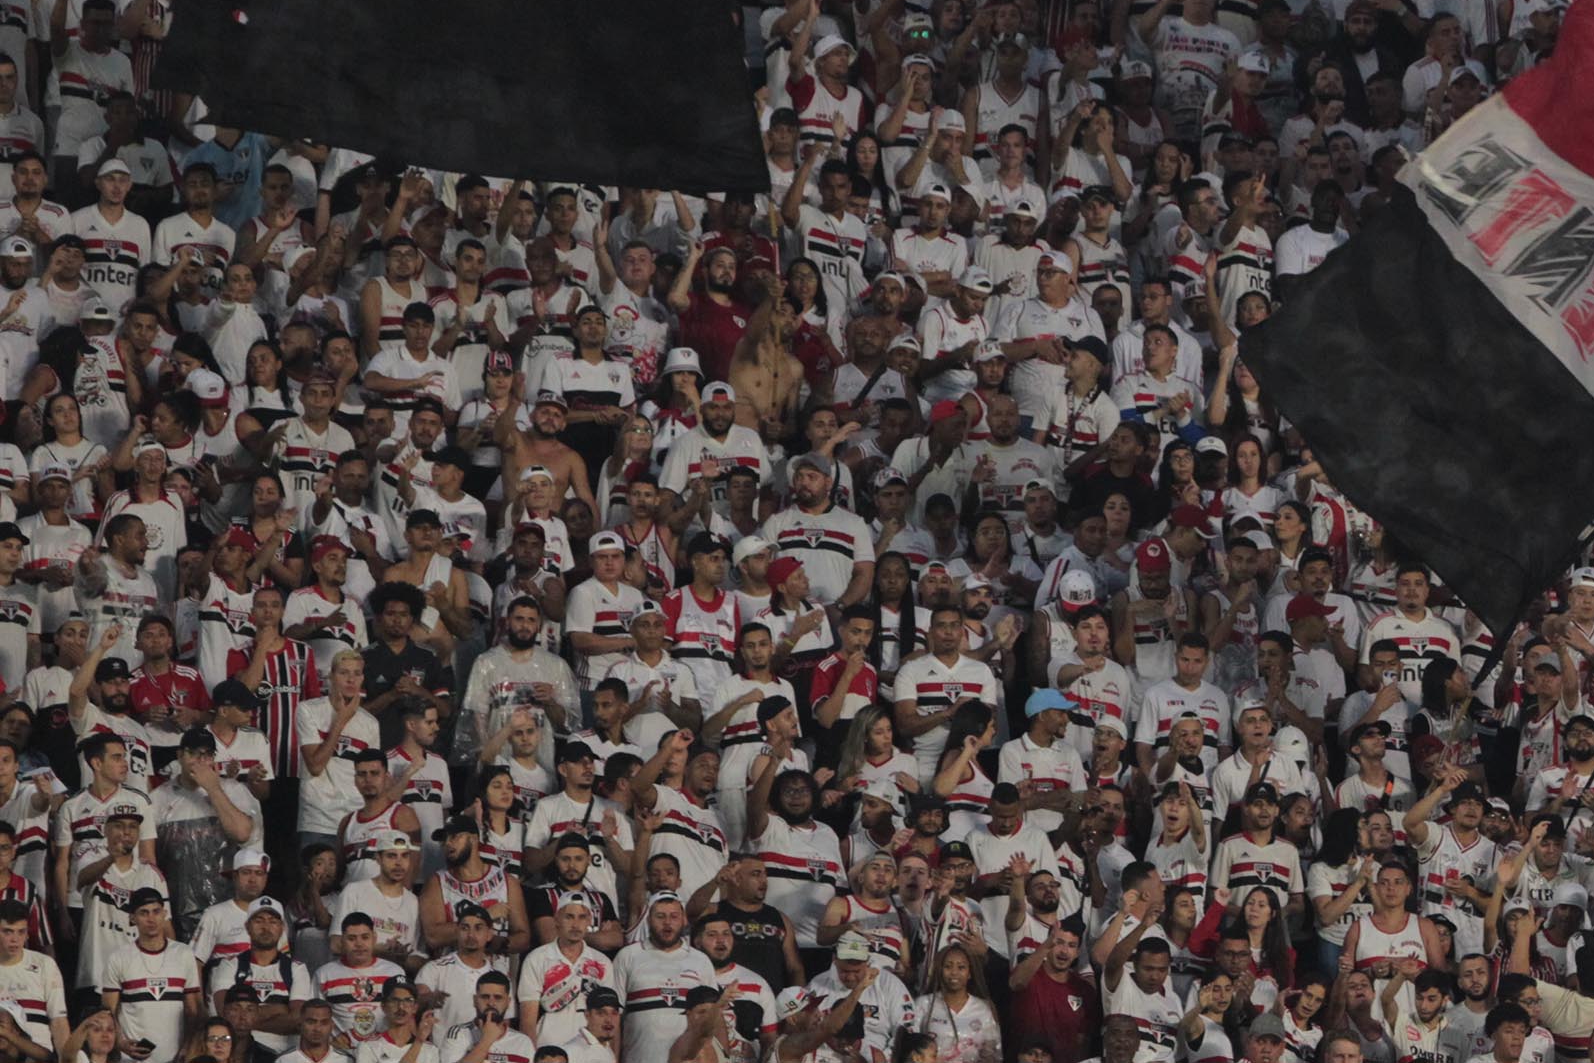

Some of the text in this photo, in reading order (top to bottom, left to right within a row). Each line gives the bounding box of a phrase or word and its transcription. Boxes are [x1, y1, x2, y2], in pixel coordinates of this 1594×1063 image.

[87, 264, 133, 285] inter
[822, 260, 845, 277] int
[294, 472, 315, 490] int
[113, 805, 136, 814] 1972
[1529, 888, 1553, 900] CIR
